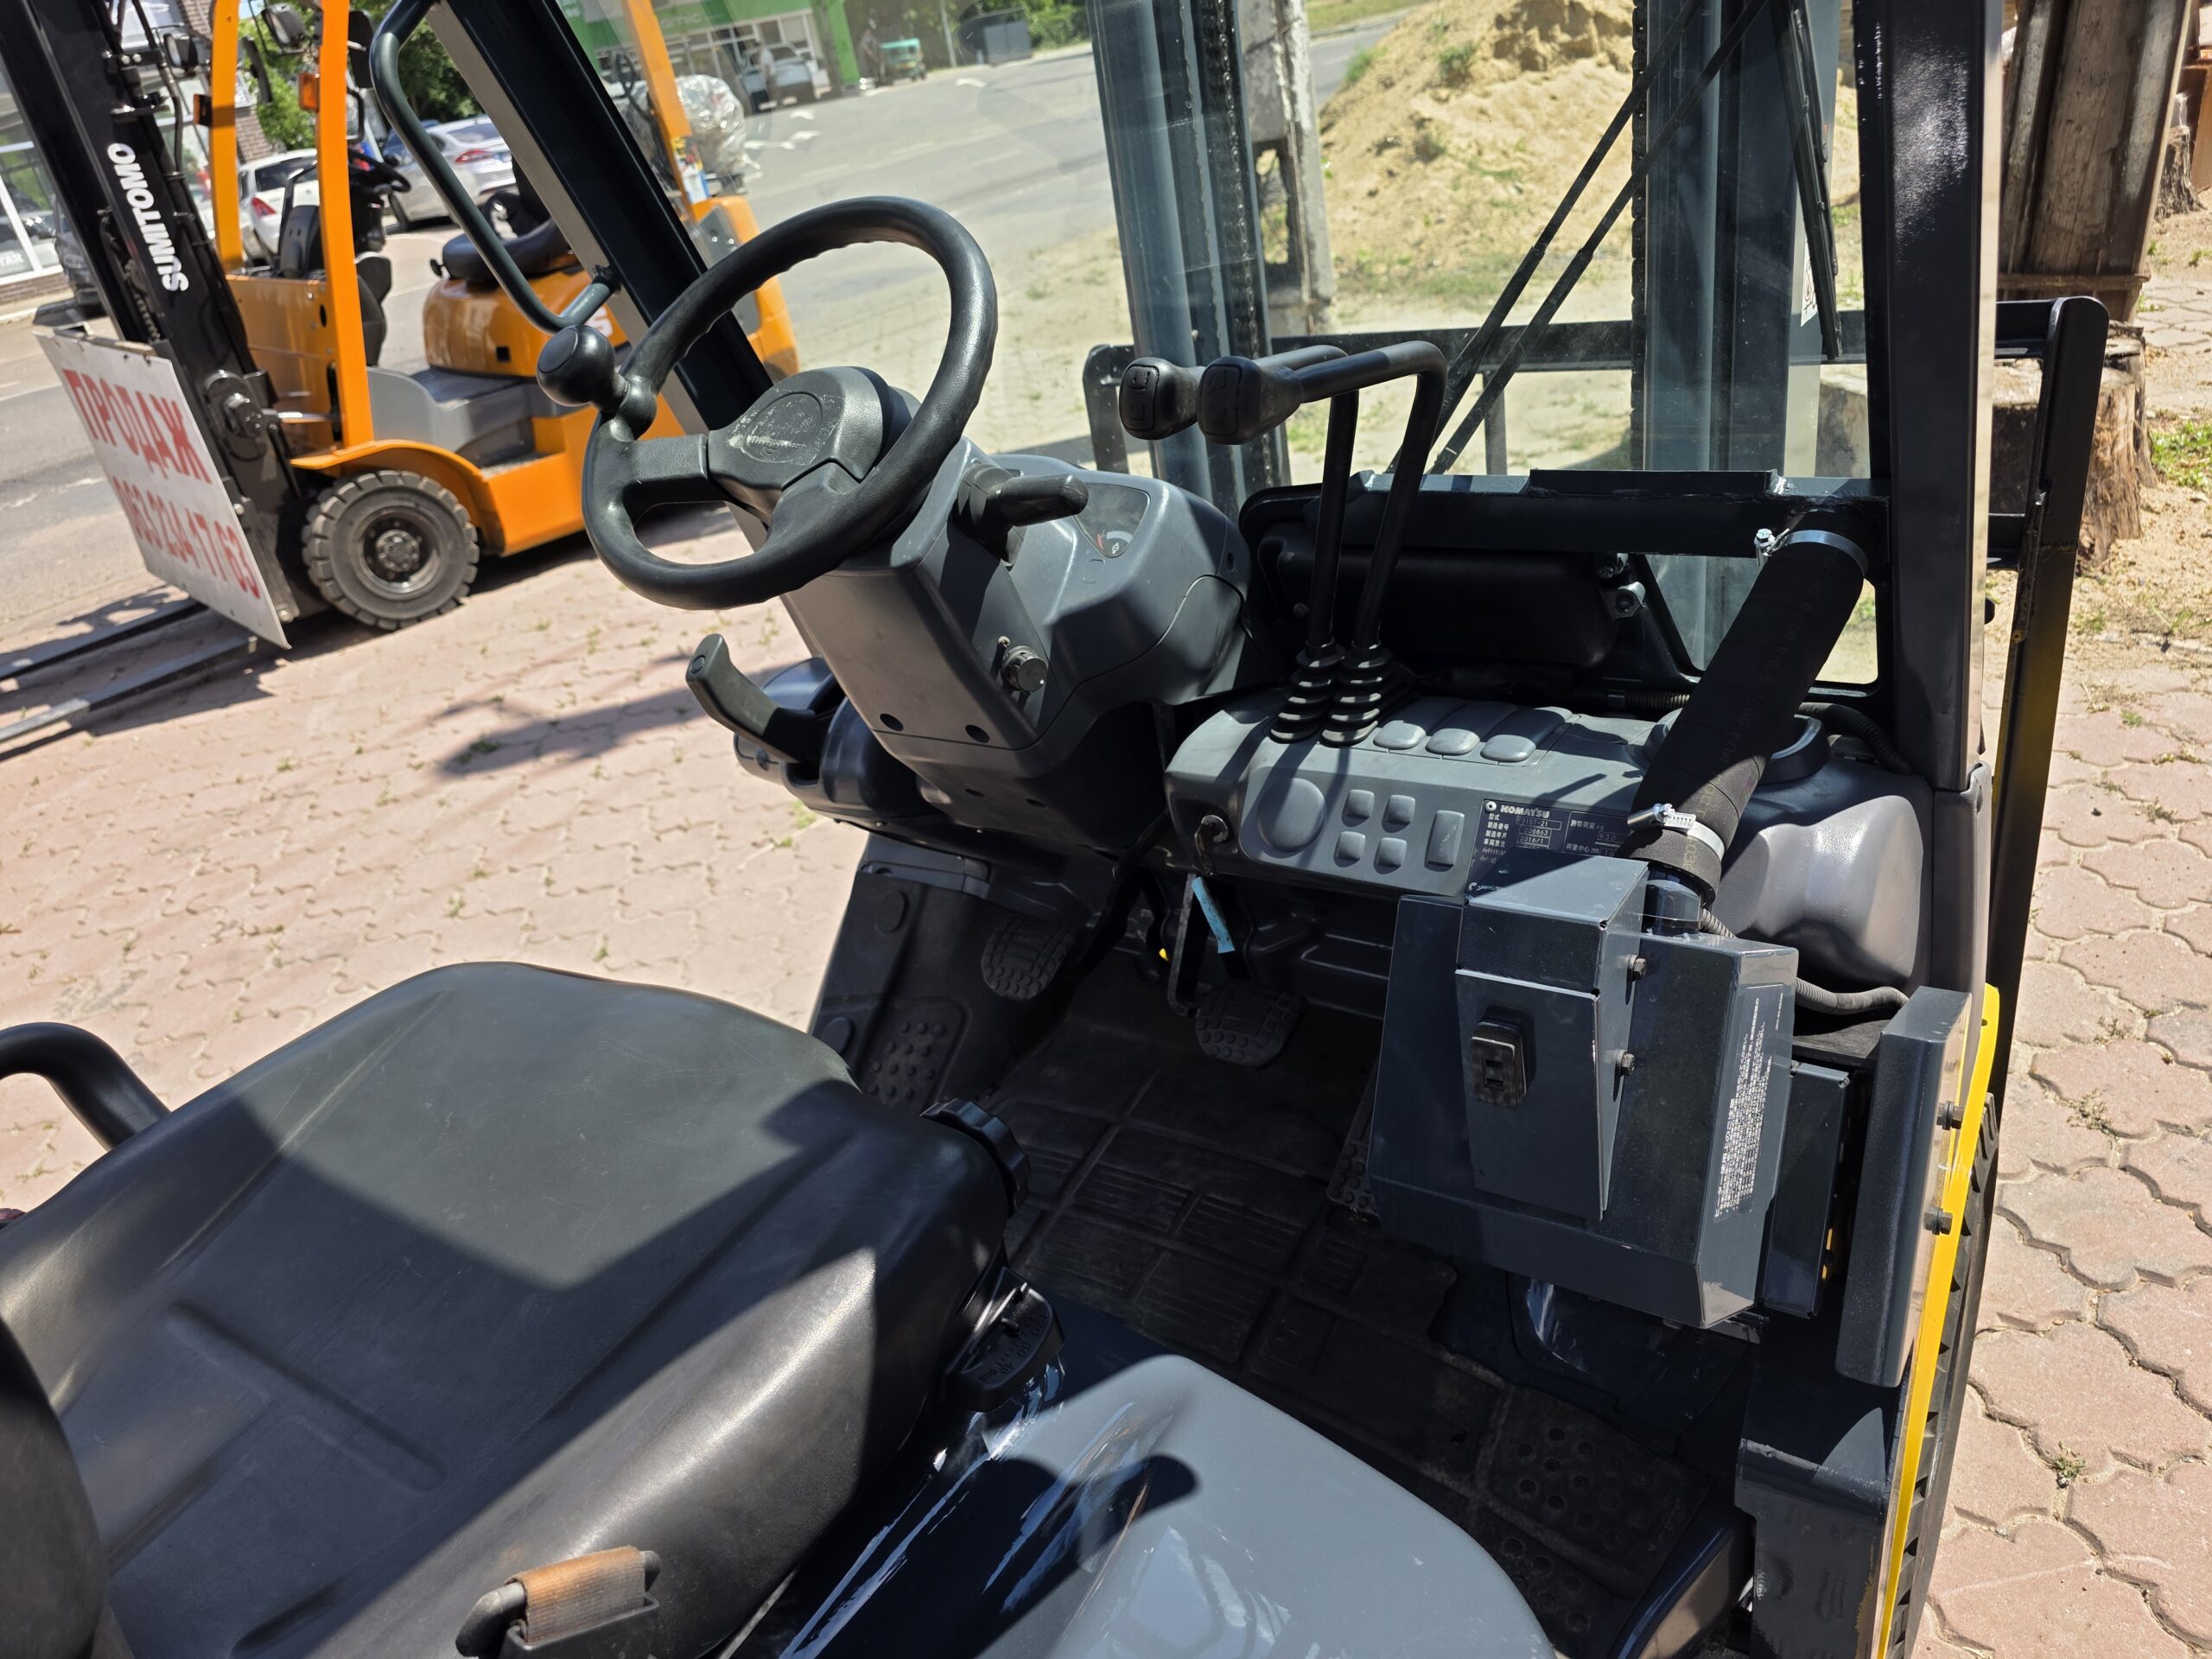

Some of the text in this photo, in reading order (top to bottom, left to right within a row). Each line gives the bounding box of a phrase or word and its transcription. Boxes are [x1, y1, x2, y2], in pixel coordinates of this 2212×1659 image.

[107, 143, 189, 292] SUMITOMO
[62, 369, 212, 484] ПРОДАЖ
[1500, 804, 1550, 818] KOMATSU
[1520, 836, 1544, 844] 2016/1
